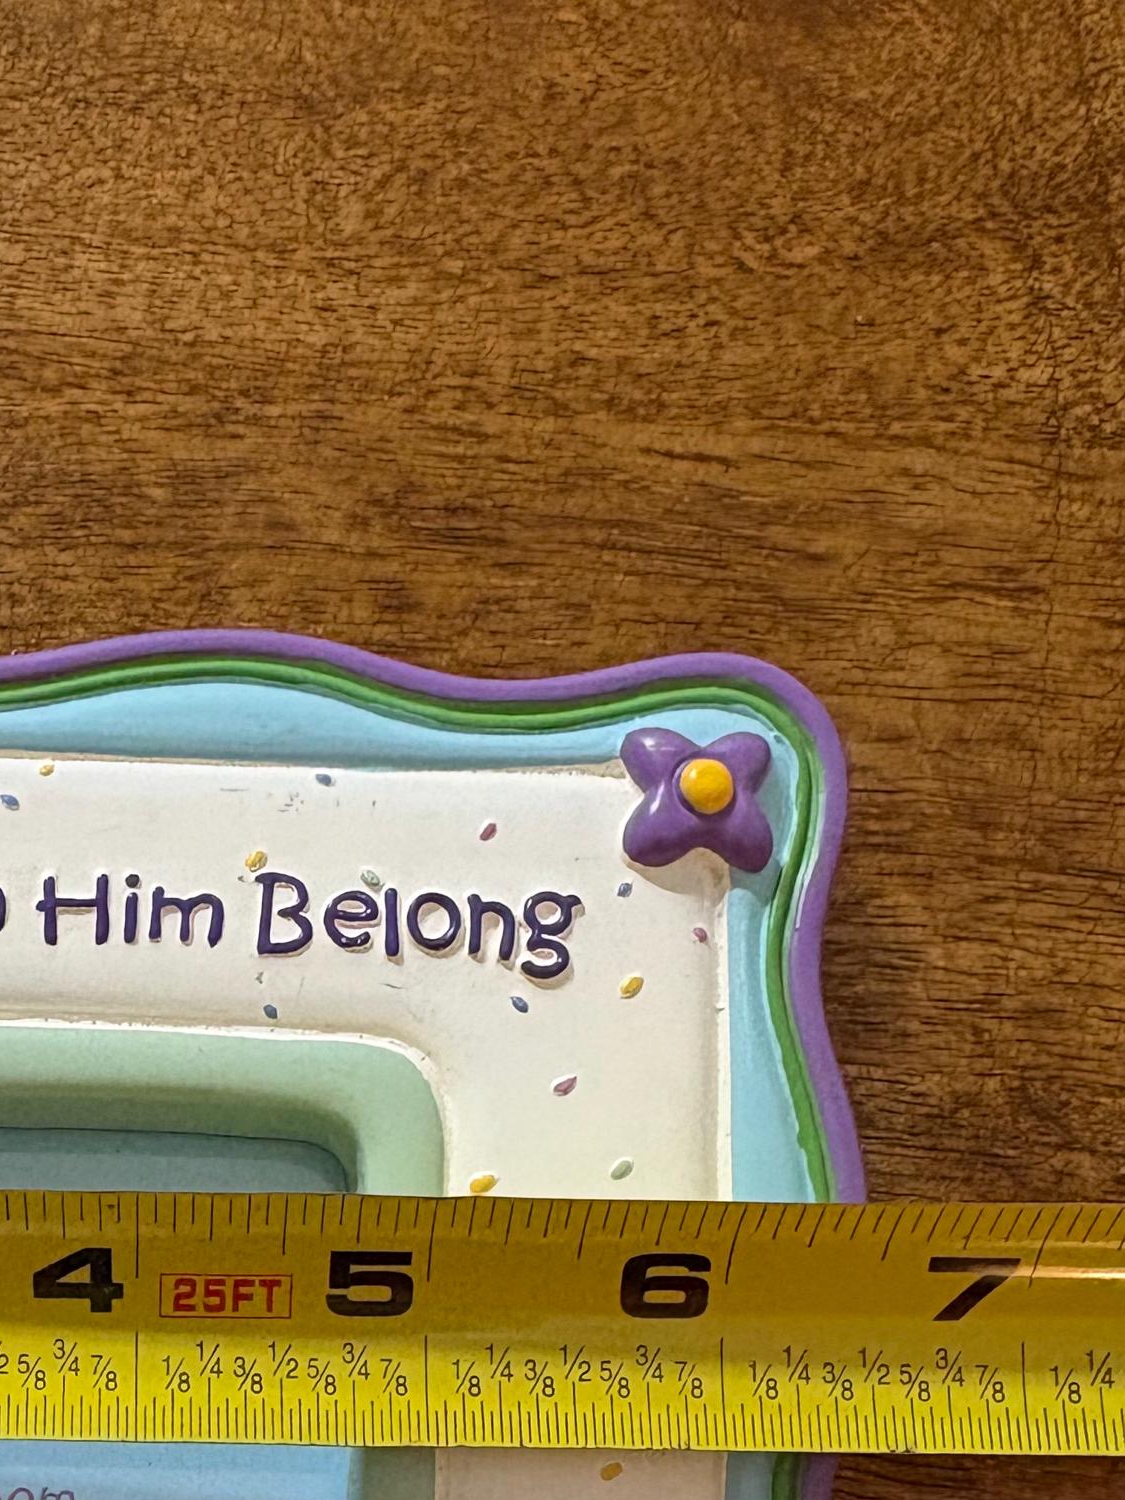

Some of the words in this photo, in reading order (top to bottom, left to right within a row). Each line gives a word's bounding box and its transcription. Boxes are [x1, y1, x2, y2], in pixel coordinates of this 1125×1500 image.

[36, 873, 225, 948] Him
[254, 872, 584, 980] Belong
[32, 1246, 124, 1313] 4
[326, 1250, 413, 1317] 5
[619, 1253, 711, 1319] 6
[928, 1256, 1021, 1321] 7
[173, 1278, 282, 1312] 25FT
[17, 1354, 46, 1390] 5/8
[53, 1339, 80, 1376] 3/4
[90, 1355, 117, 1391] 7/8
[162, 1356, 191, 1393] 1/8
[196, 1341, 223, 1378] 1/4
[233, 1357, 263, 1394] 3/8
[268, 1341, 299, 1379] 1/2
[306, 1358, 337, 1395] 5/8
[342, 1343, 371, 1380] 3/4
[380, 1359, 408, 1396] 7/8
[452, 1359, 481, 1397] 1/8
[485, 1344, 514, 1382] 1/4
[524, 1359, 555, 1397] 3/8
[559, 1345, 592, 1382] 1/2
[600, 1361, 630, 1398] 5/8
[636, 1345, 664, 1383] 3/4
[674, 1362, 703, 1399] 7/8
[749, 1360, 778, 1400] 1/8
[782, 1346, 811, 1385] 1/4
[822, 1362, 854, 1401] 3/8
[858, 1348, 890, 1386] 1/2
[900, 1363, 930, 1402] 5/8
[935, 1348, 965, 1386] 3/4
[975, 1365, 1005, 1403] 7/8
[1049, 1365, 1081, 1404] 1/8
[1085, 1349, 1115, 1389] 1/4
